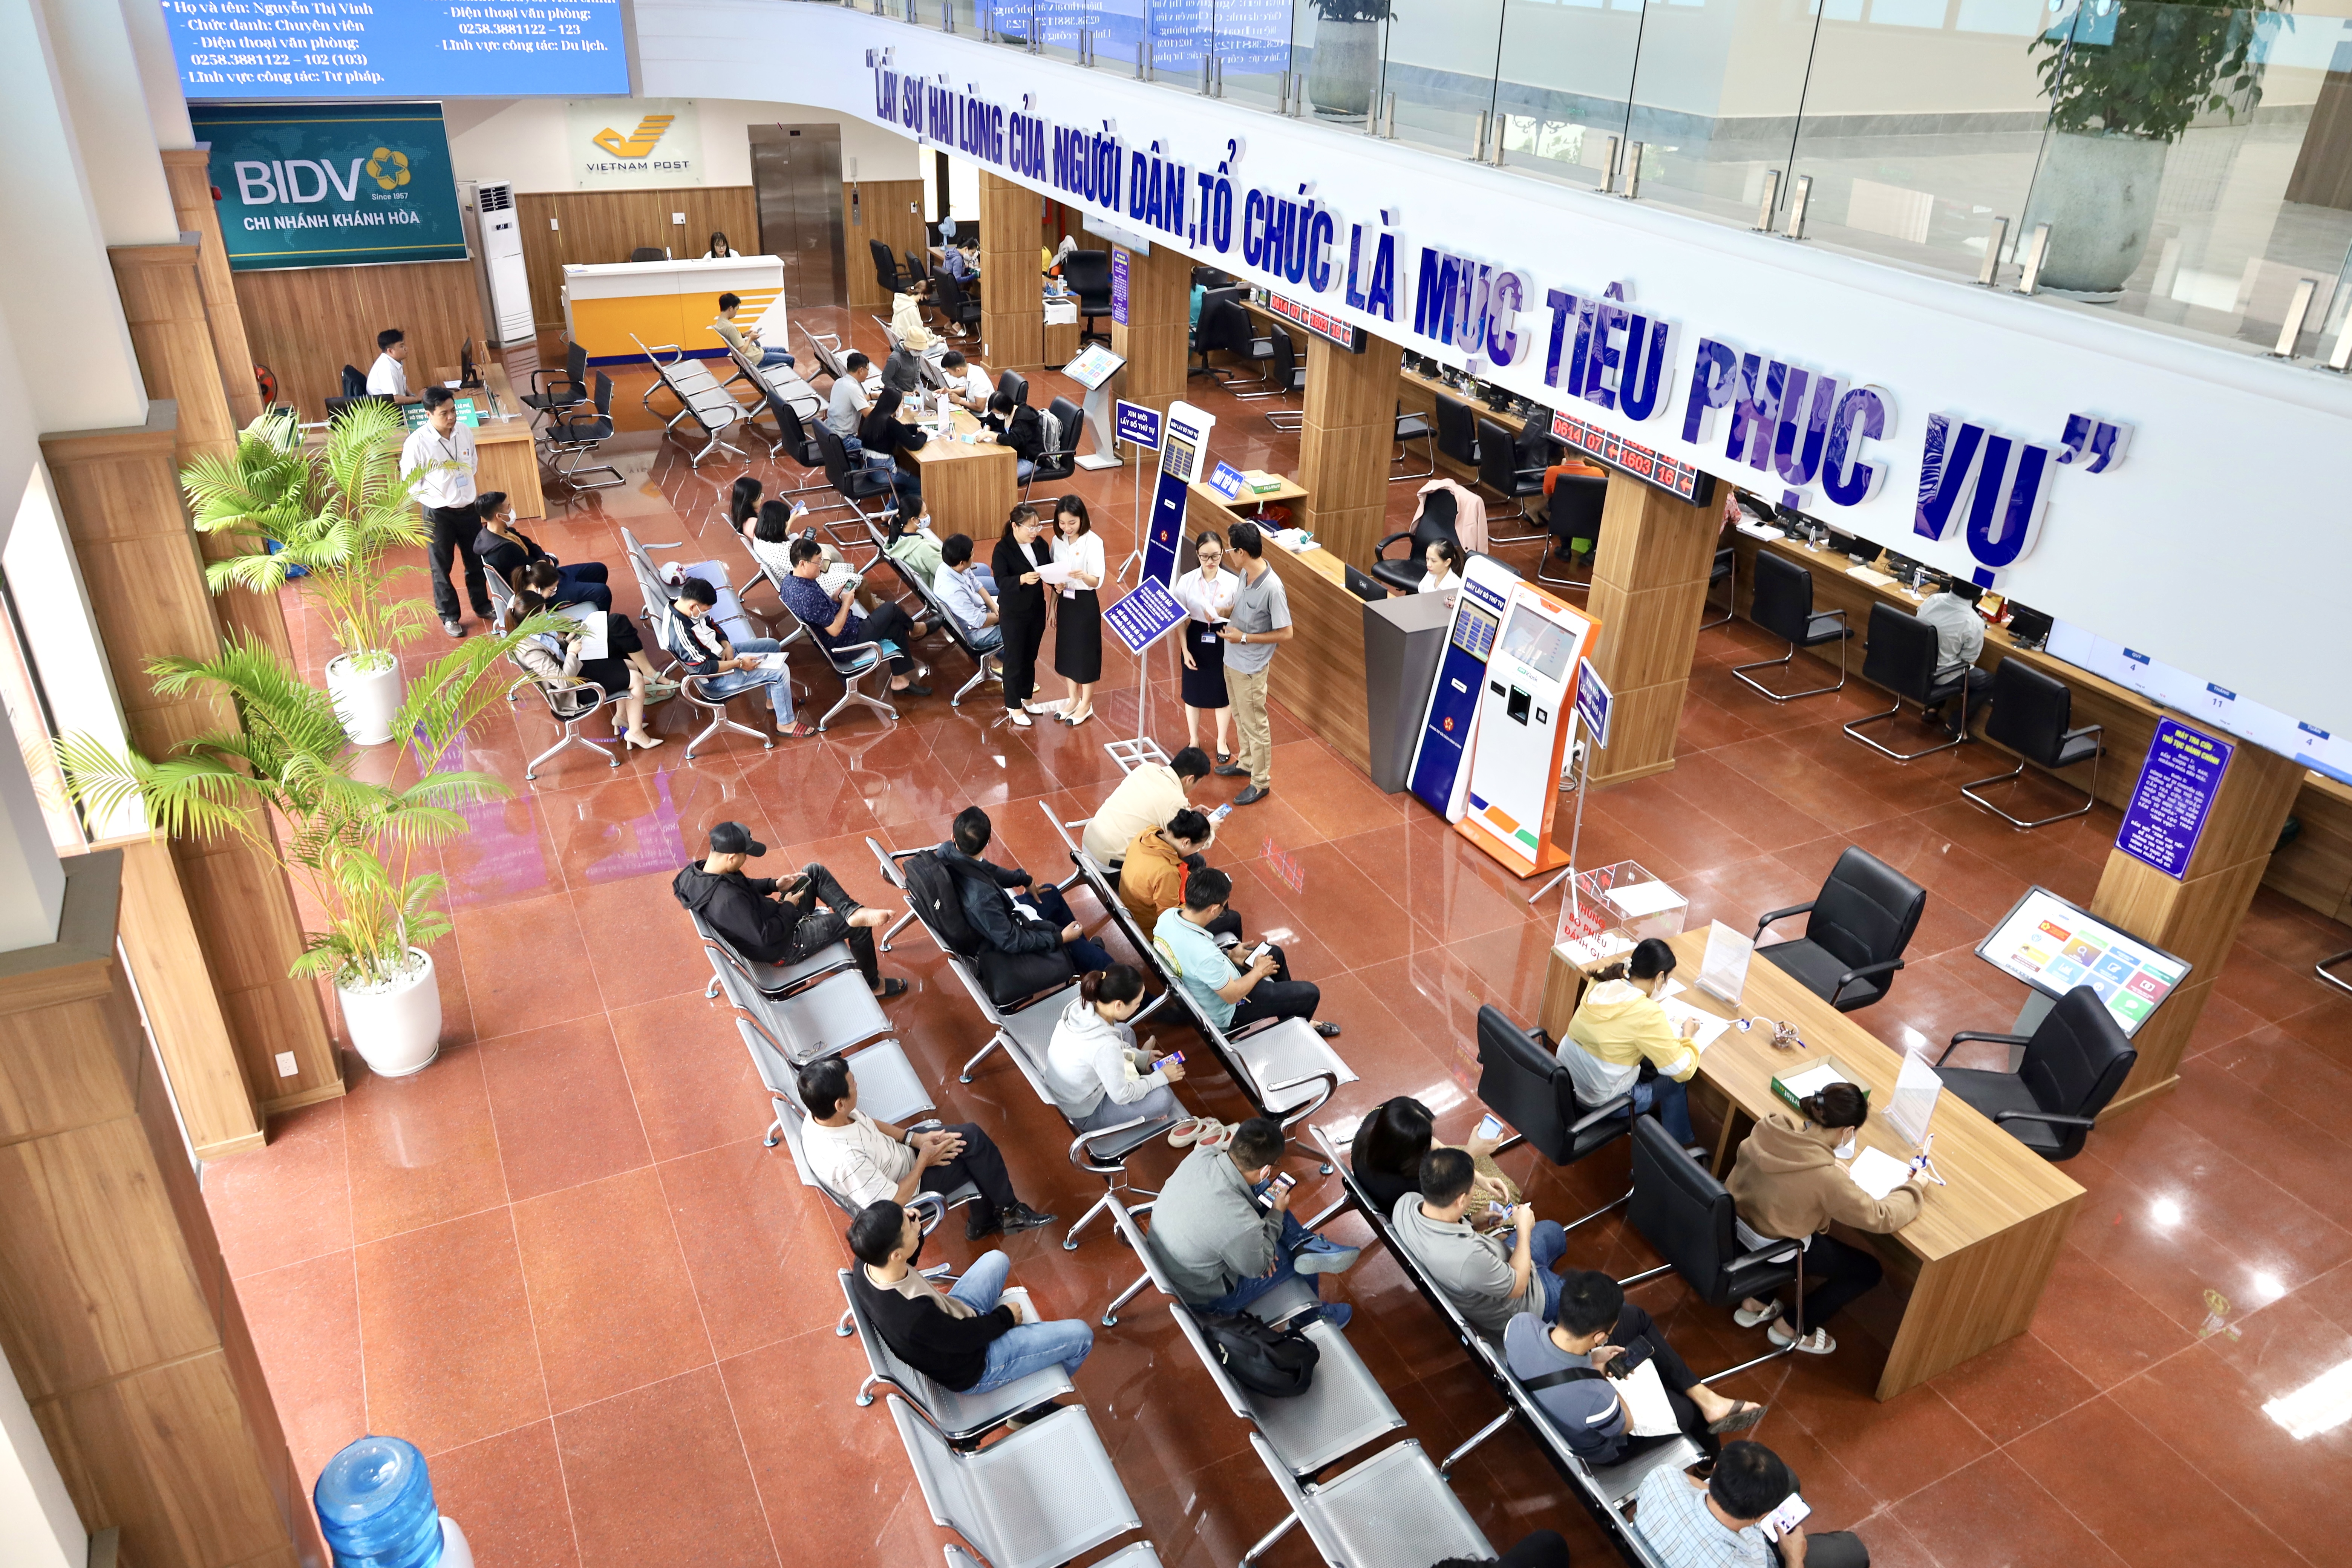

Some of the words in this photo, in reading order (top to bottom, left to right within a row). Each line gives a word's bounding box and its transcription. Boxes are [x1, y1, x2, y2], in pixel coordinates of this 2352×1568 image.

[175, 1, 197, 15] Họ
[199, 2, 219, 14] và
[222, 2, 250, 14] tên:
[254, 1, 309, 17] Nguyễn
[312, 2, 337, 17] Thị
[339, 2, 373, 15] Vinh
[450, 7, 481, 19] Điện
[484, 7, 518, 20] thoại
[521, 8, 545, 18] văn
[548, 7, 591, 21] phòng:
[188, 18, 227, 31] Chức
[229, 19, 273, 31] danh:
[275, 19, 330, 34] Chuyên
[334, 20, 364, 31] viên
[459, 24, 546, 35] 0258.3881122
[559, 23, 581, 35] 123
[201, 37, 236, 50] Điện
[239, 37, 277, 50] thoại
[280, 38, 308, 48] văn
[311, 37, 360, 51] phòng:
[442, 39, 473, 51] Lĩnh
[476, 41, 500, 52] vực
[502, 39, 534, 52] công
[536, 40, 558, 51] tác:
[561, 40, 579, 51] Du
[582, 39, 608, 52] lịch.
[191, 54, 291, 65] 0258.3881122
[304, 54, 329, 65] 102
[332, 54, 367, 66] (103)
[189, 71, 224, 83] Lĩnh
[227, 73, 254, 85] vực
[257, 71, 292, 85] công
[294, 71, 320, 82] tác:
[322, 71, 343, 82] Tư
[346, 70, 384, 84] pháp.
[586, 162, 647, 171] VIETNAM
[654, 161, 689, 169] POST
[234, 158, 365, 205] BIDV
[243, 216, 271, 231] CHI
[275, 212, 329, 230] NHÁNH
[333, 210, 385, 227] KHÁNH
[389, 208, 420, 224] HÒA
[903, 75, 924, 144] SỰ
[928, 74, 954, 147] HÀI
[959, 83, 1003, 166] LÒNG
[1009, 93, 1047, 182] CỦA
[1054, 119, 1122, 212] NGƯỜI
[1243, 182, 1333, 293] CHỨC
[1346, 208, 1395, 322] LÀ
[1414, 247, 1523, 374] MỤC
[1544, 281, 1671, 421] TIÊU
[1681, 337, 1886, 510] PHỤC
[1290, 305, 1300, 318] 07
[1127, 410, 1136, 418] XIN
[1138, 413, 1148, 422] MỜI
[1120, 416, 1129, 426] LẤY
[1130, 420, 1138, 428] SỐ
[1138, 423, 1148, 432] THỨ
[1148, 427, 1155, 436] TỰ
[1554, 418, 1582, 444] 0614
[1586, 433, 1603, 452] 07
[1620, 449, 1652, 475] 1603
[1657, 465, 1675, 486] 16
[1465, 581, 1475, 591] MÁY
[1525, 671, 1538, 682] Kiosk
[2213, 698, 2222, 707] 11
[2175, 730, 2188, 740] MÁY
[2188, 735, 2200, 745] TRA
[2184, 744, 2201, 756] HÀNH
[2200, 751, 2220, 764] CHÍNH
[1564, 925, 1588, 950] ĐÁNH
